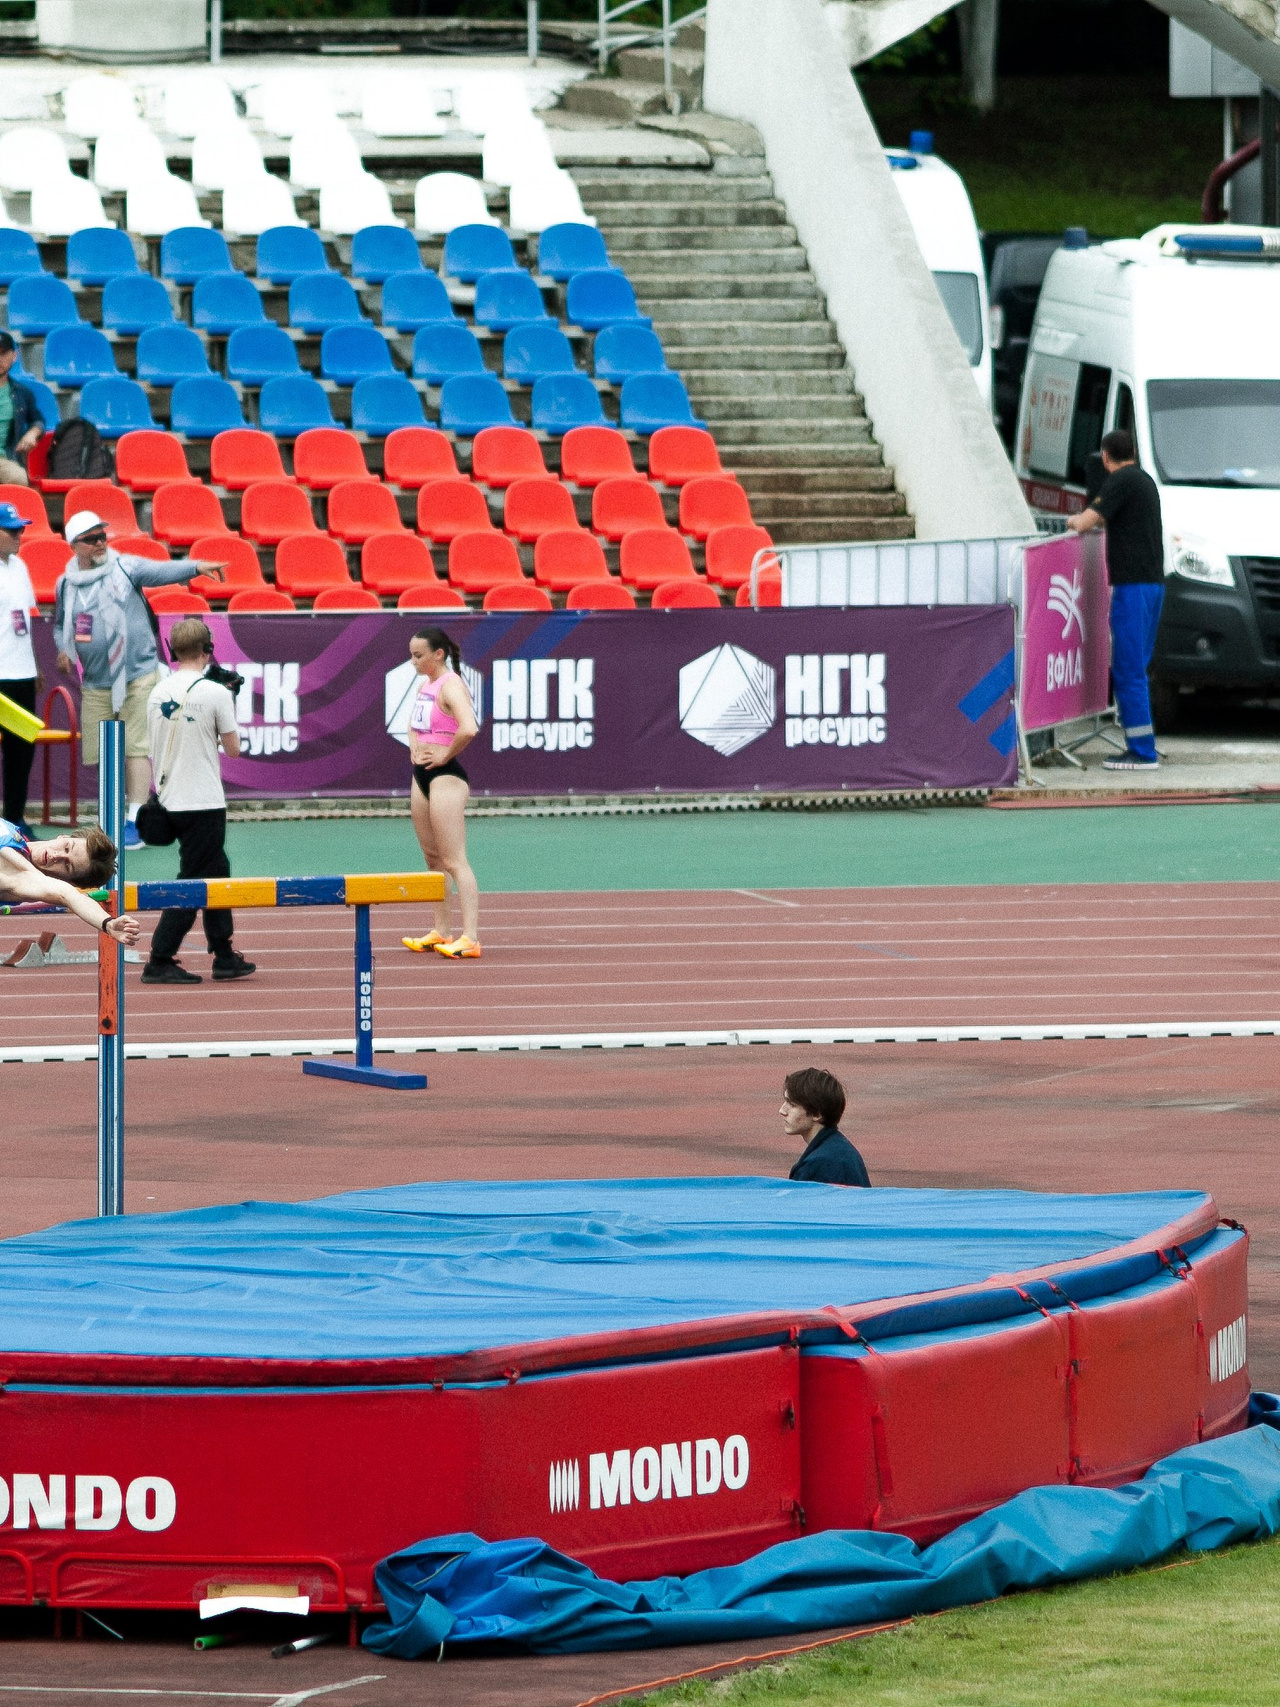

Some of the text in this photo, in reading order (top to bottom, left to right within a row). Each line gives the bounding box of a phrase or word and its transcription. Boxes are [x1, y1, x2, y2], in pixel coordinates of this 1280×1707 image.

[204, 662, 300, 724] ГК
[492, 658, 594, 720] НГК
[785, 653, 886, 715] НГК
[1046, 646, 1083, 692] ВФЛА
[492, 721, 593, 752] ресурс
[785, 716, 886, 748] ресурс
[360, 971, 372, 1032] MONDO
[589, 1434, 750, 1510] MONDO
